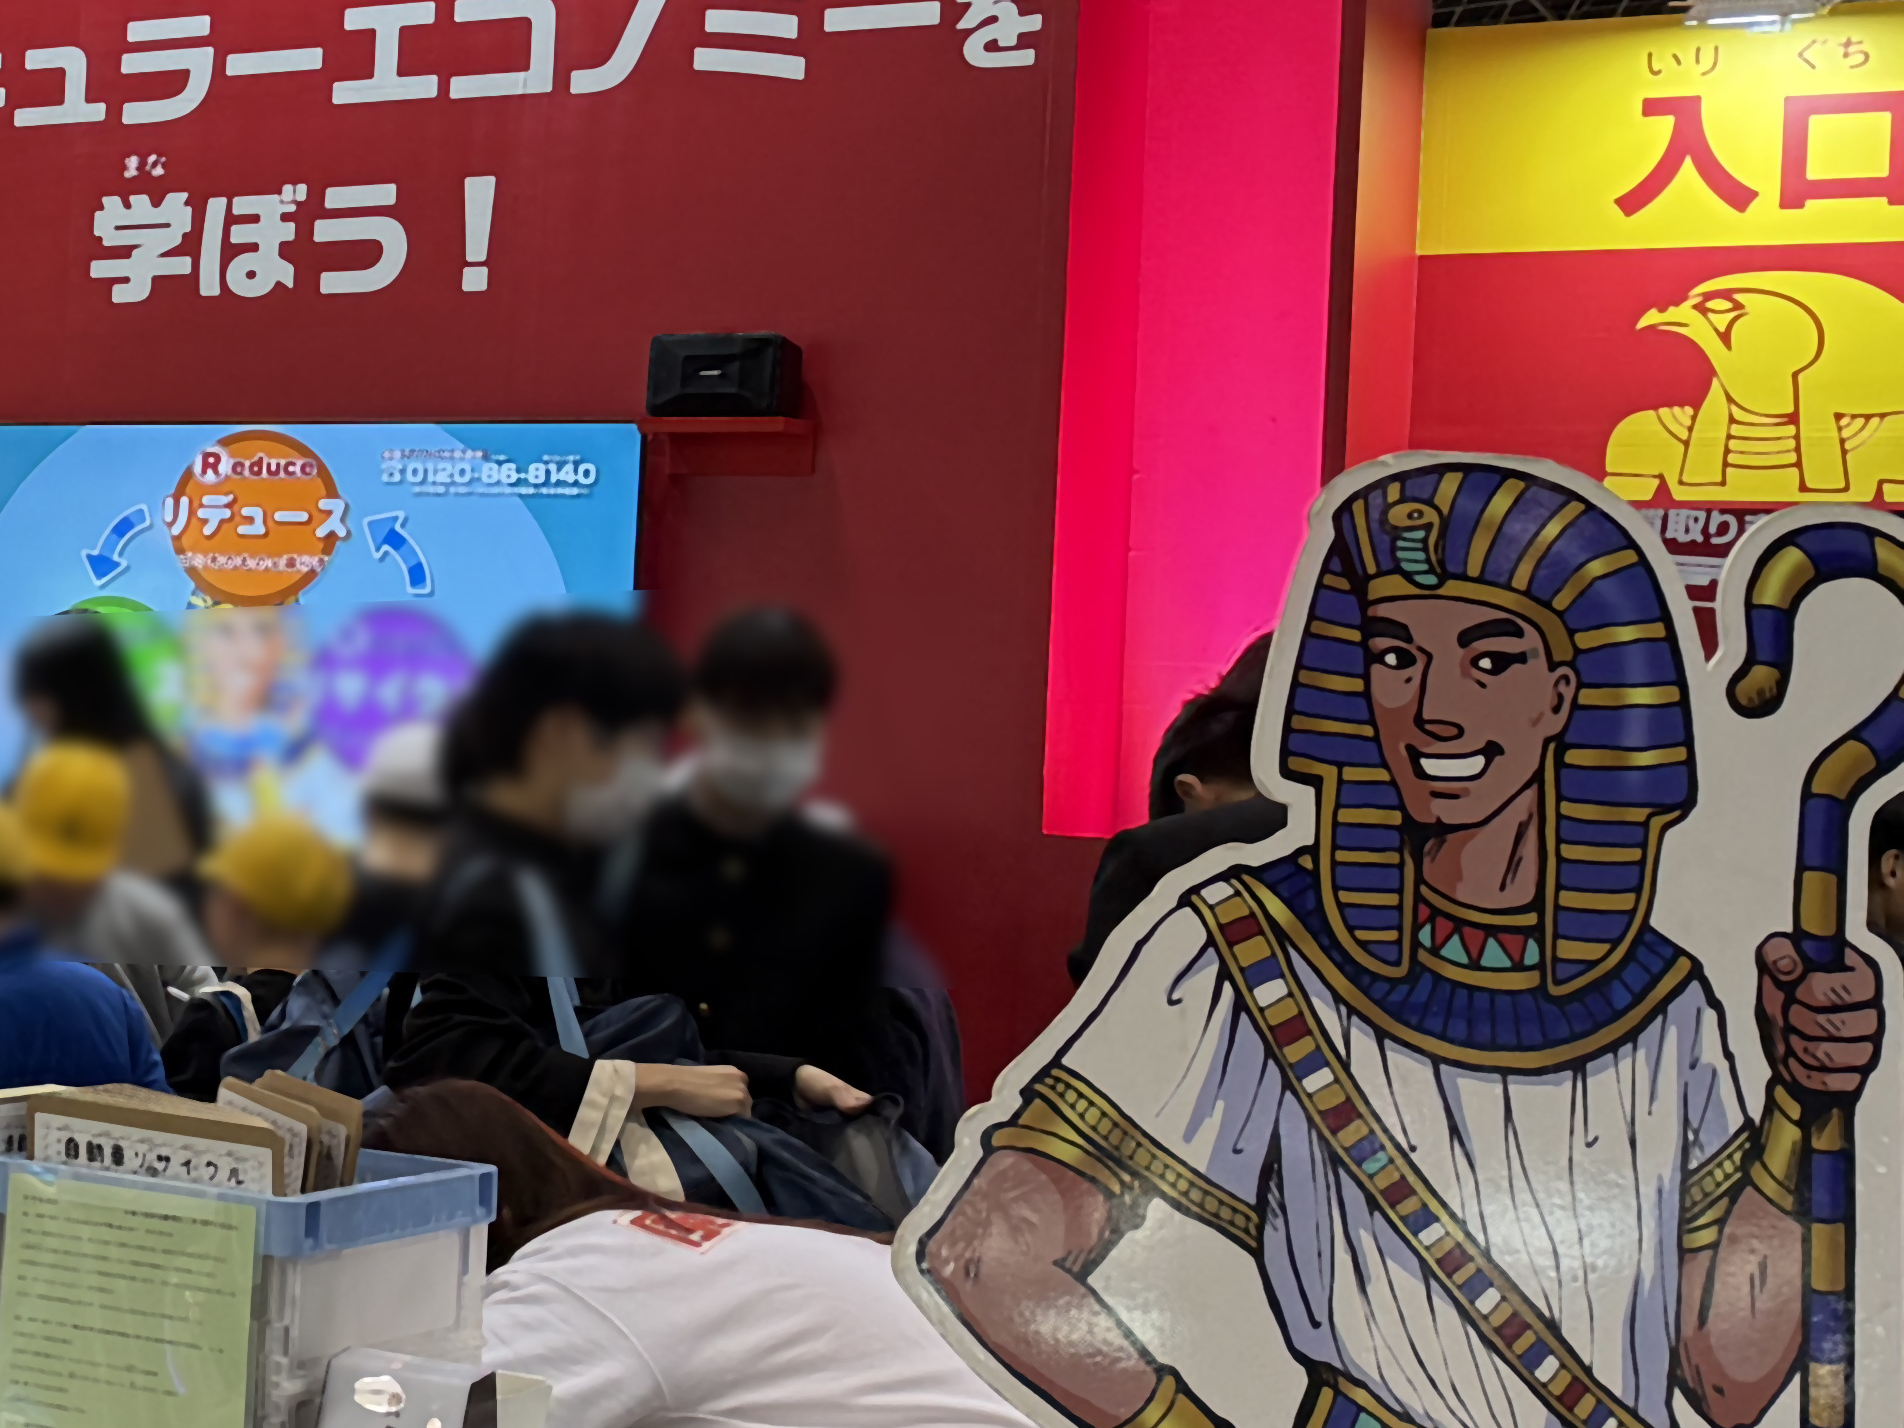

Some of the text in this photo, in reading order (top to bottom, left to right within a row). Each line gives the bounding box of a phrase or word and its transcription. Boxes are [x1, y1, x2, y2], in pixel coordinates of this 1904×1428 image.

[1646, 43, 1721, 76] いり
[1796, 36, 1871, 70] ぐち
[1613, 90, 1904, 217] 入口
[88, 174, 497, 304] 学ぼう！
[163, 492, 348, 539] リデュース
